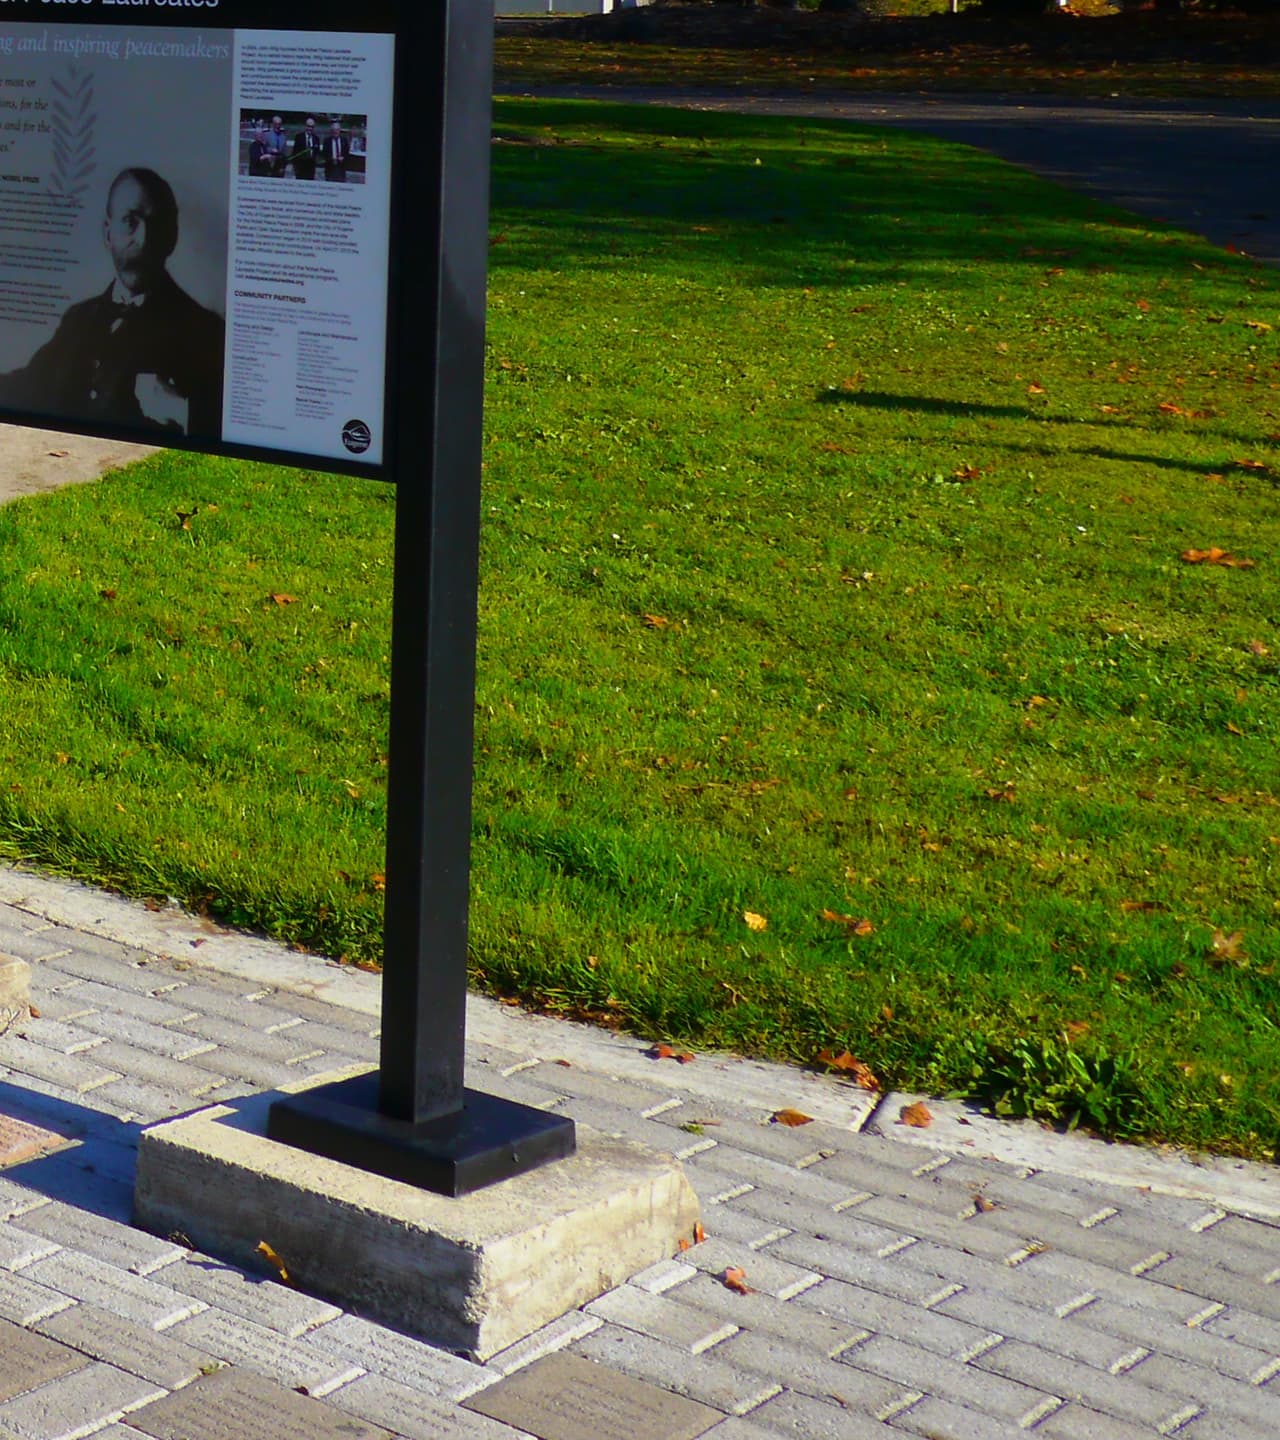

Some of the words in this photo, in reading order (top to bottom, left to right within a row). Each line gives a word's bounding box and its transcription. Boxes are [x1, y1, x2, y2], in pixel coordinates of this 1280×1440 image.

[17, 30, 48, 52] and
[54, 32, 122, 58] inspiring
[125, 36, 229, 59] peacemakers
